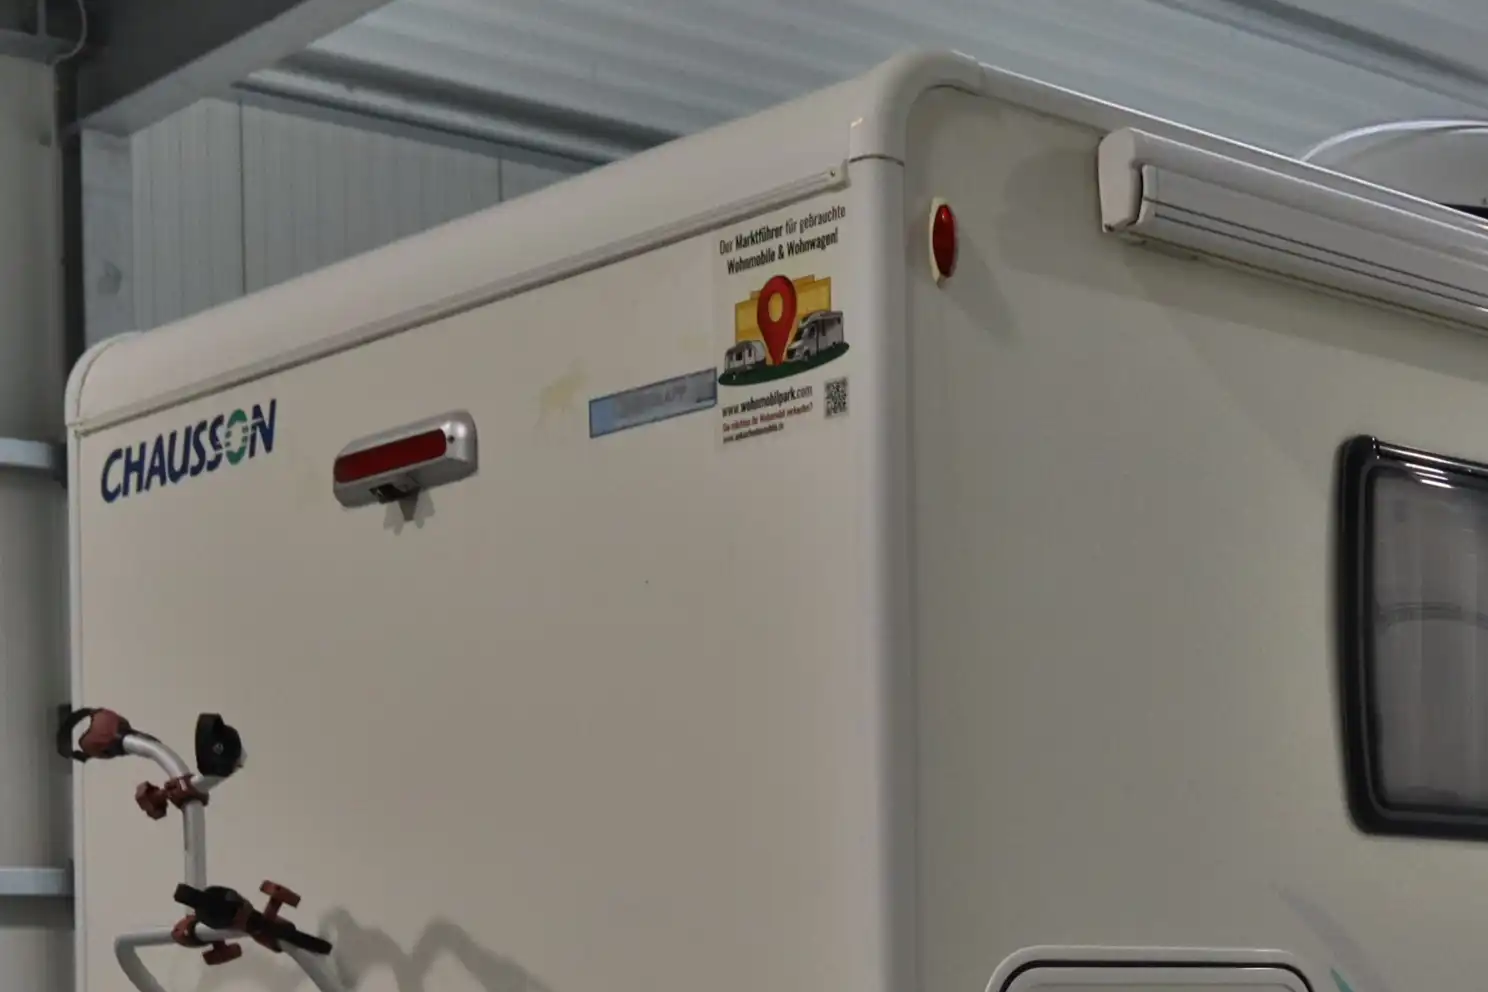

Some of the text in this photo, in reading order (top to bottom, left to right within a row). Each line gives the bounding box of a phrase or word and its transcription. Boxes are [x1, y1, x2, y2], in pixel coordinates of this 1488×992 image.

[735, 223, 784, 251] Marktführer
[777, 244, 785, 260] &
[100, 398, 277, 503] CHAUSSON
